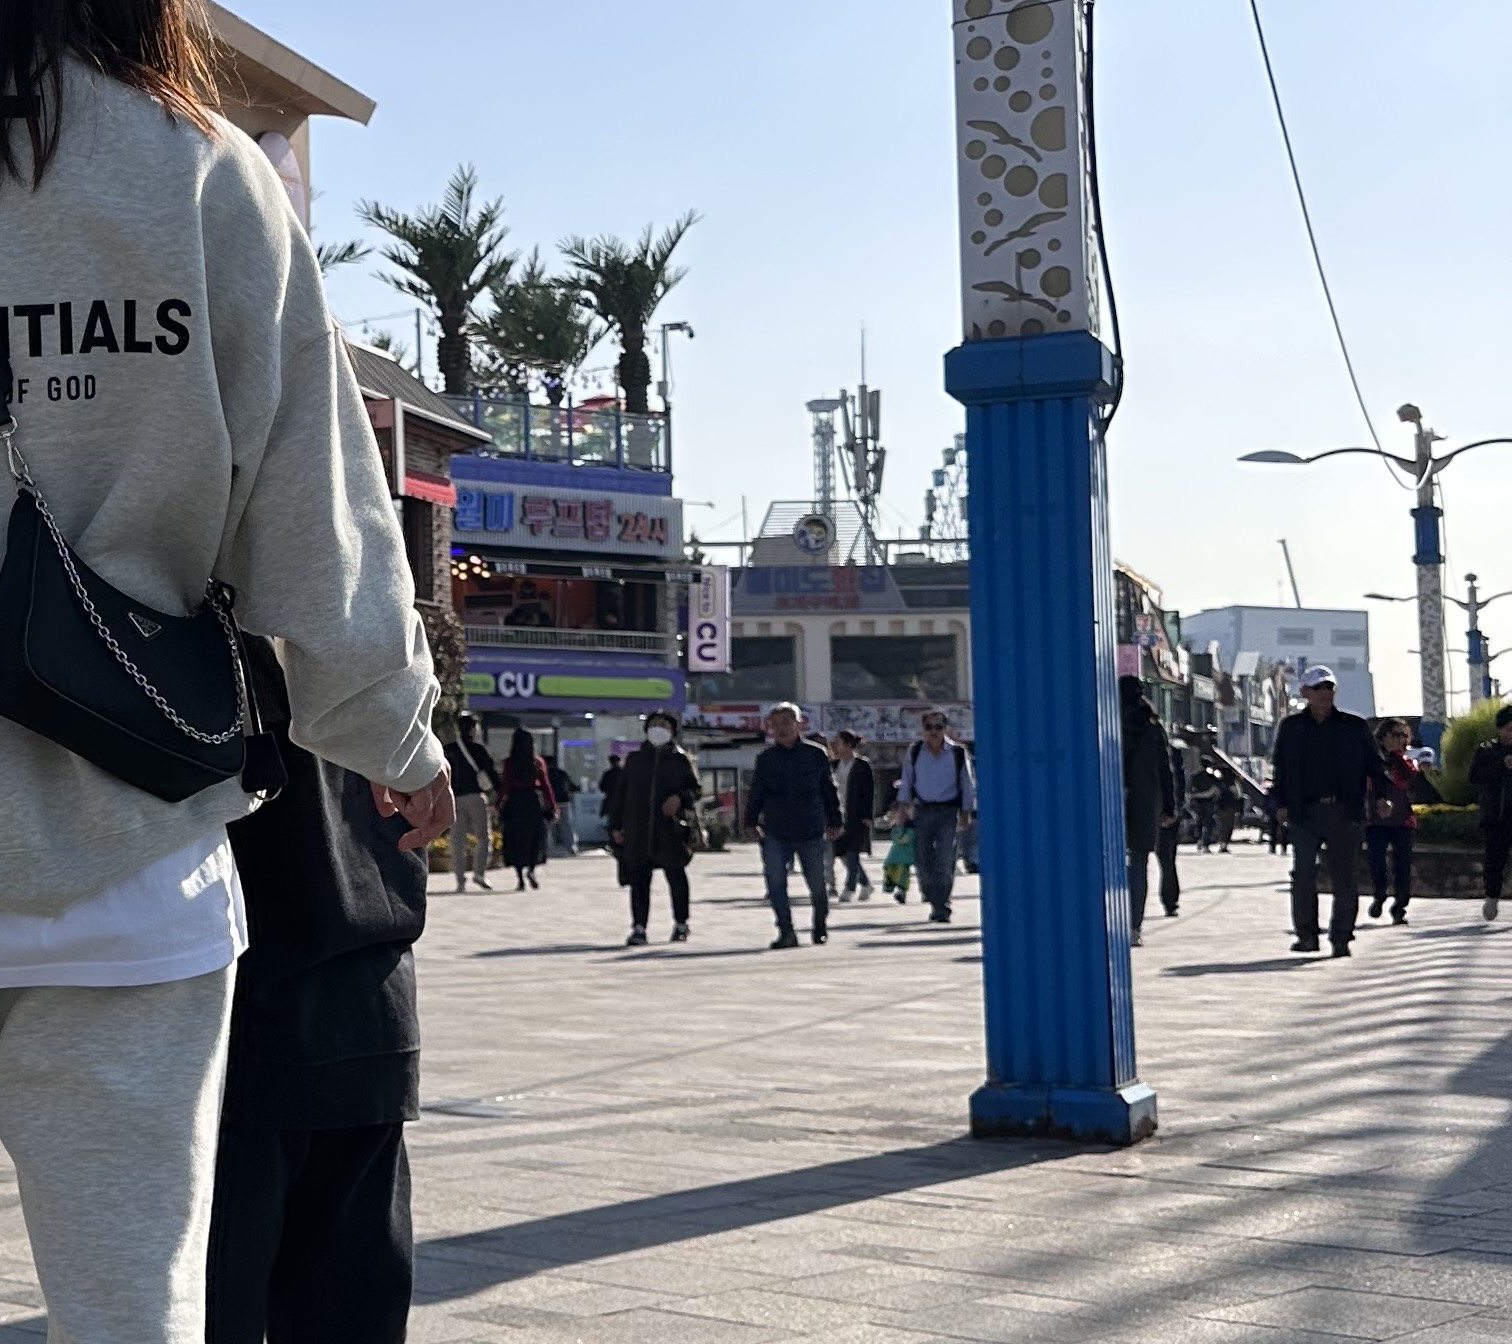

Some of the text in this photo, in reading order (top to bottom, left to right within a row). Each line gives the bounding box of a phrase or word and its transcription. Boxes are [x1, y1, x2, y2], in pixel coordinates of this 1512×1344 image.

[47, 374, 97, 402] GOD
[696, 622, 717, 662] CU
[498, 671, 535, 698] CU
